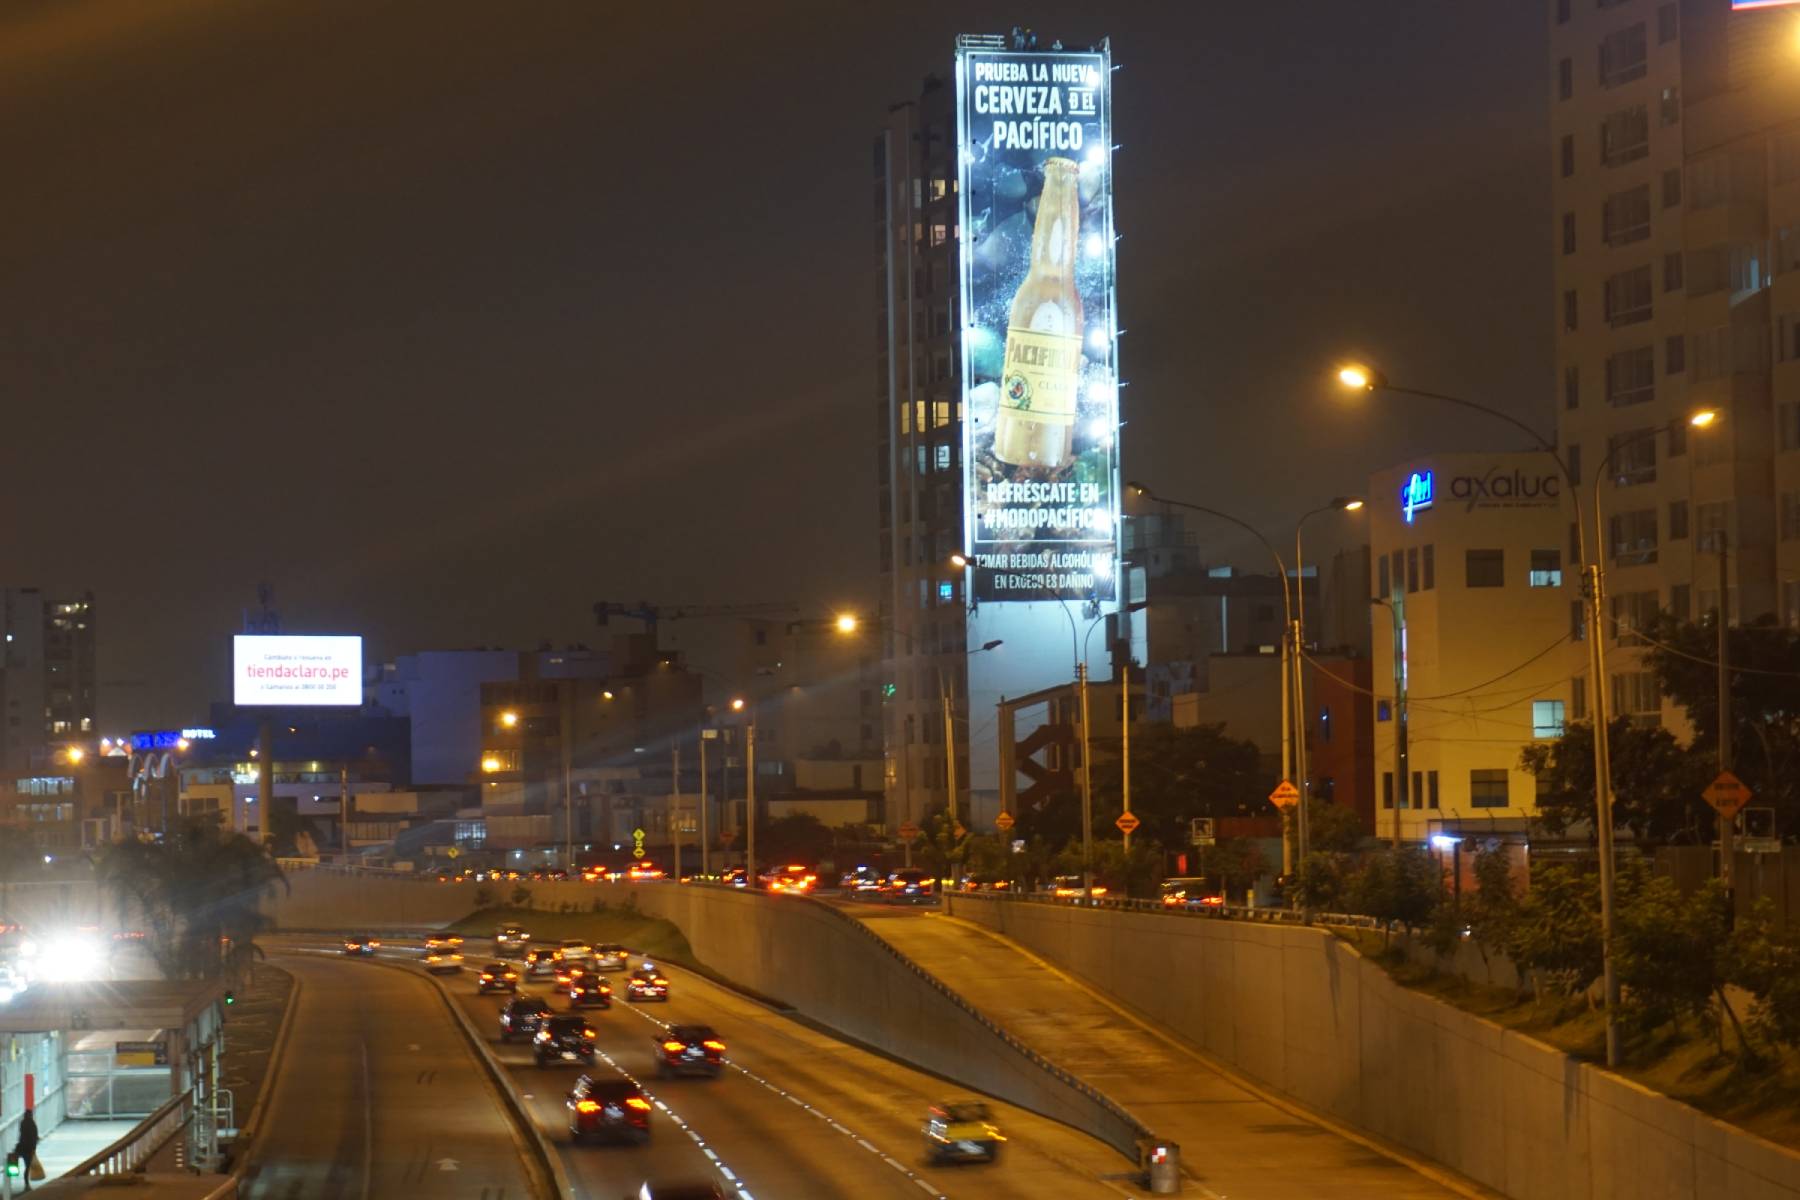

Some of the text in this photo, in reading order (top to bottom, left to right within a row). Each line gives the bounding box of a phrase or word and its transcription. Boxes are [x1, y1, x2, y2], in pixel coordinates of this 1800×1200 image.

[975, 63, 1099, 83] PRUEBA LA NUEVA
[974, 85, 1062, 114] CERVEZA
[993, 116, 1083, 149] PACÍFICO
[987, 480, 1099, 502] REFRÉSCATE EN
[983, 504, 1109, 529] #MODOPACÍFIC
[975, 551, 1112, 569] TOMAR BEBIDAS ALCOHÓLIS
[994, 574, 1007, 589] EN
[1046, 575, 1058, 589] ES
[247, 664, 349, 681] tiendaclaro.pe
